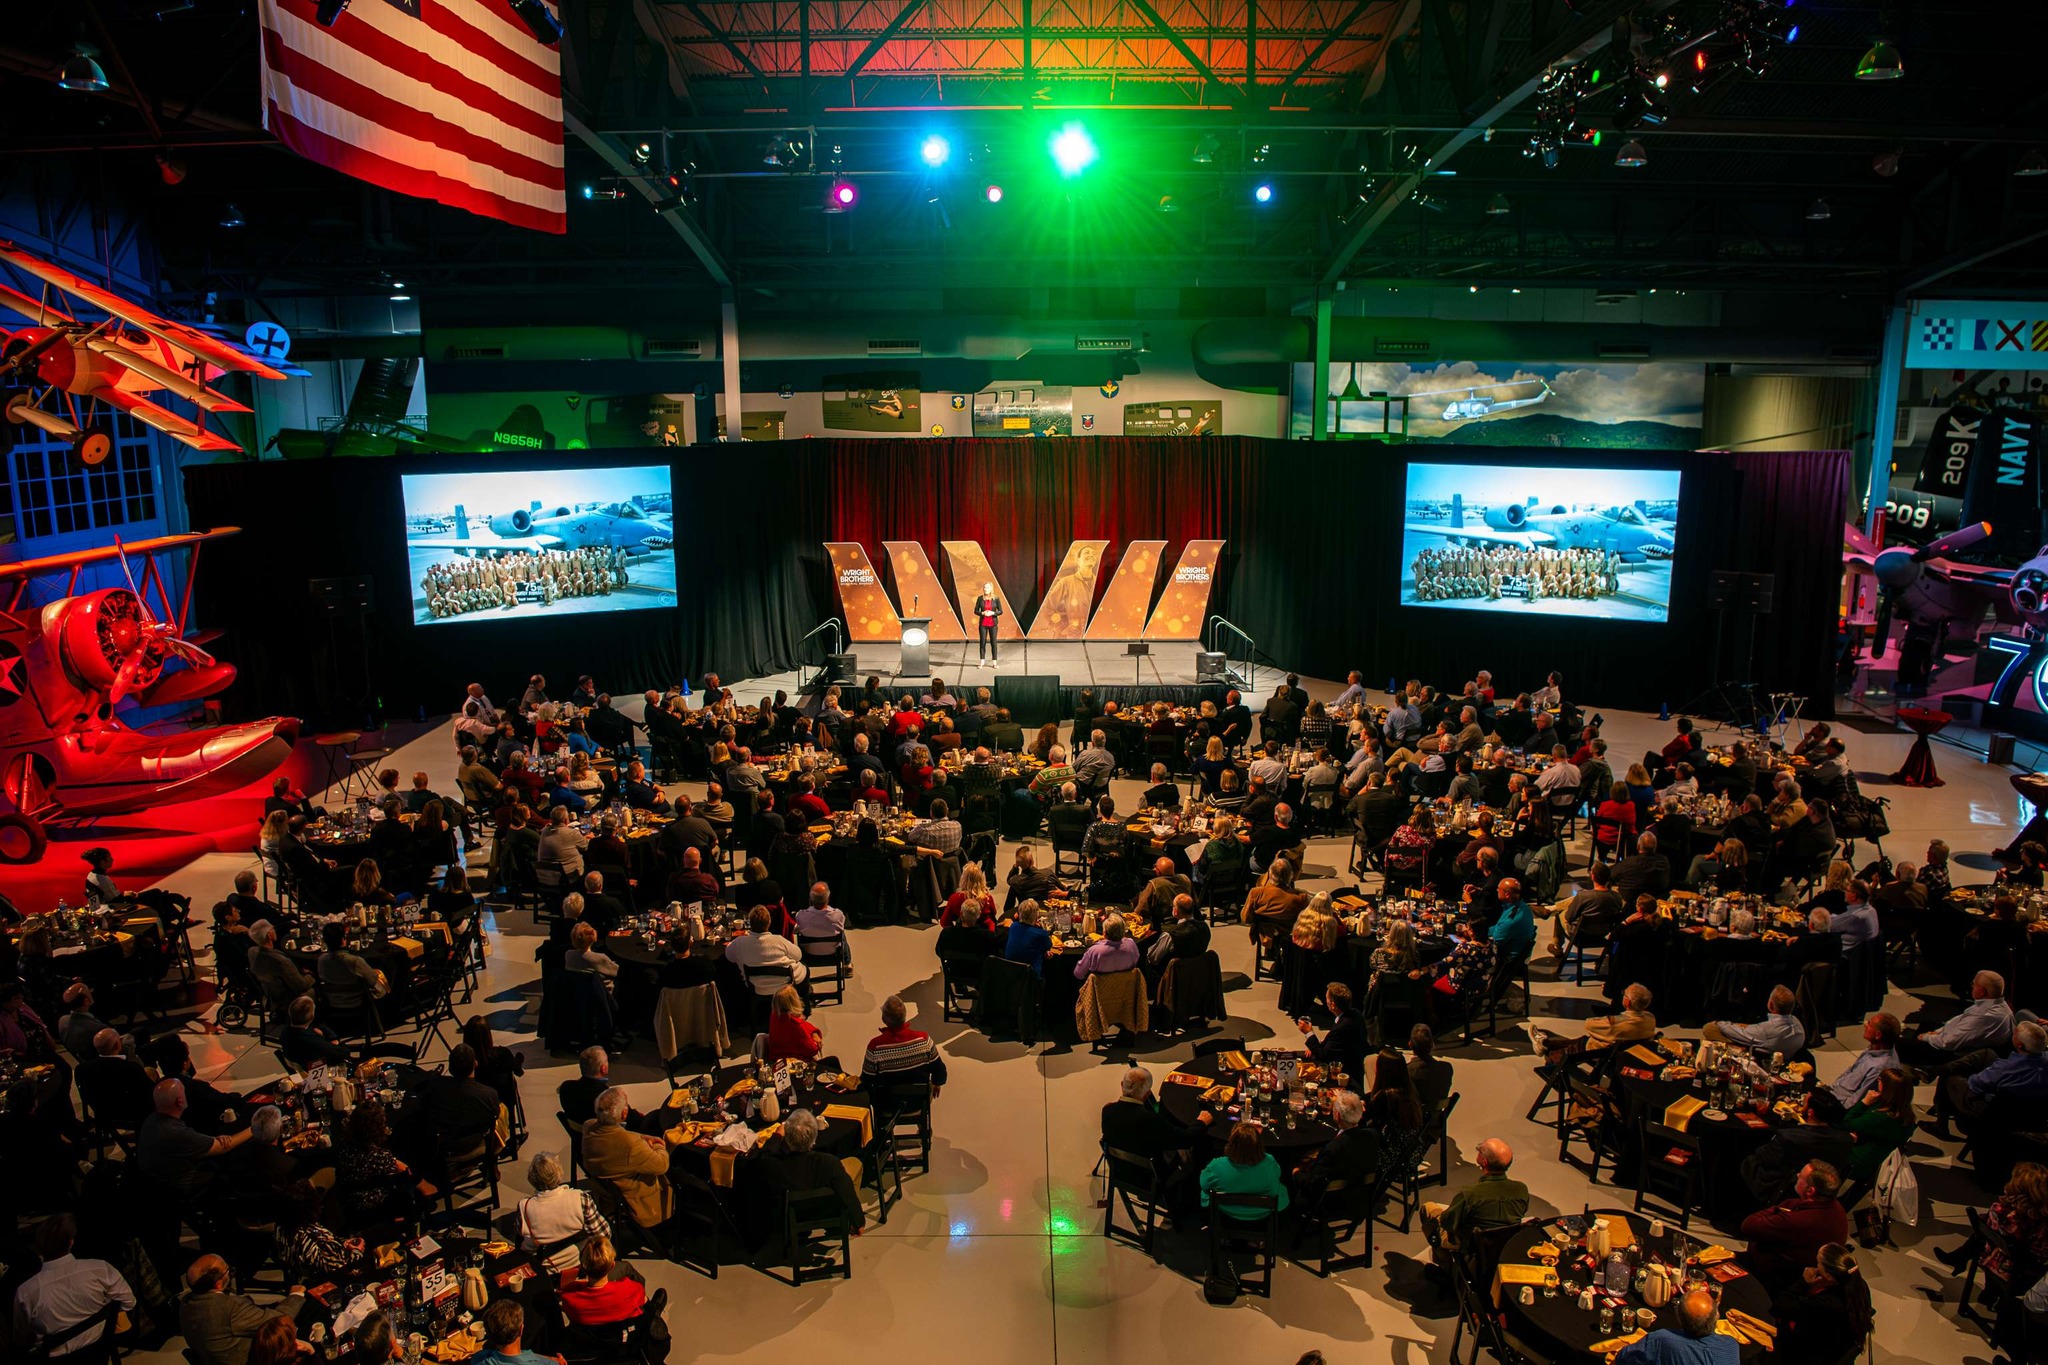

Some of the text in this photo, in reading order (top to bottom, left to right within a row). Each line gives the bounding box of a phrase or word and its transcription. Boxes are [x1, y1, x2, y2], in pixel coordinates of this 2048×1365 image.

[493, 431, 543, 450] N9658H
[1942, 416, 1983, 485] 209 K
[1996, 417, 2032, 486] NAVY
[405, 905, 419, 914] 20
[1279, 1061, 1294, 1070] 29
[312, 1067, 325, 1080] 27
[776, 1069, 787, 1082] 28
[425, 1272, 442, 1289] 35
